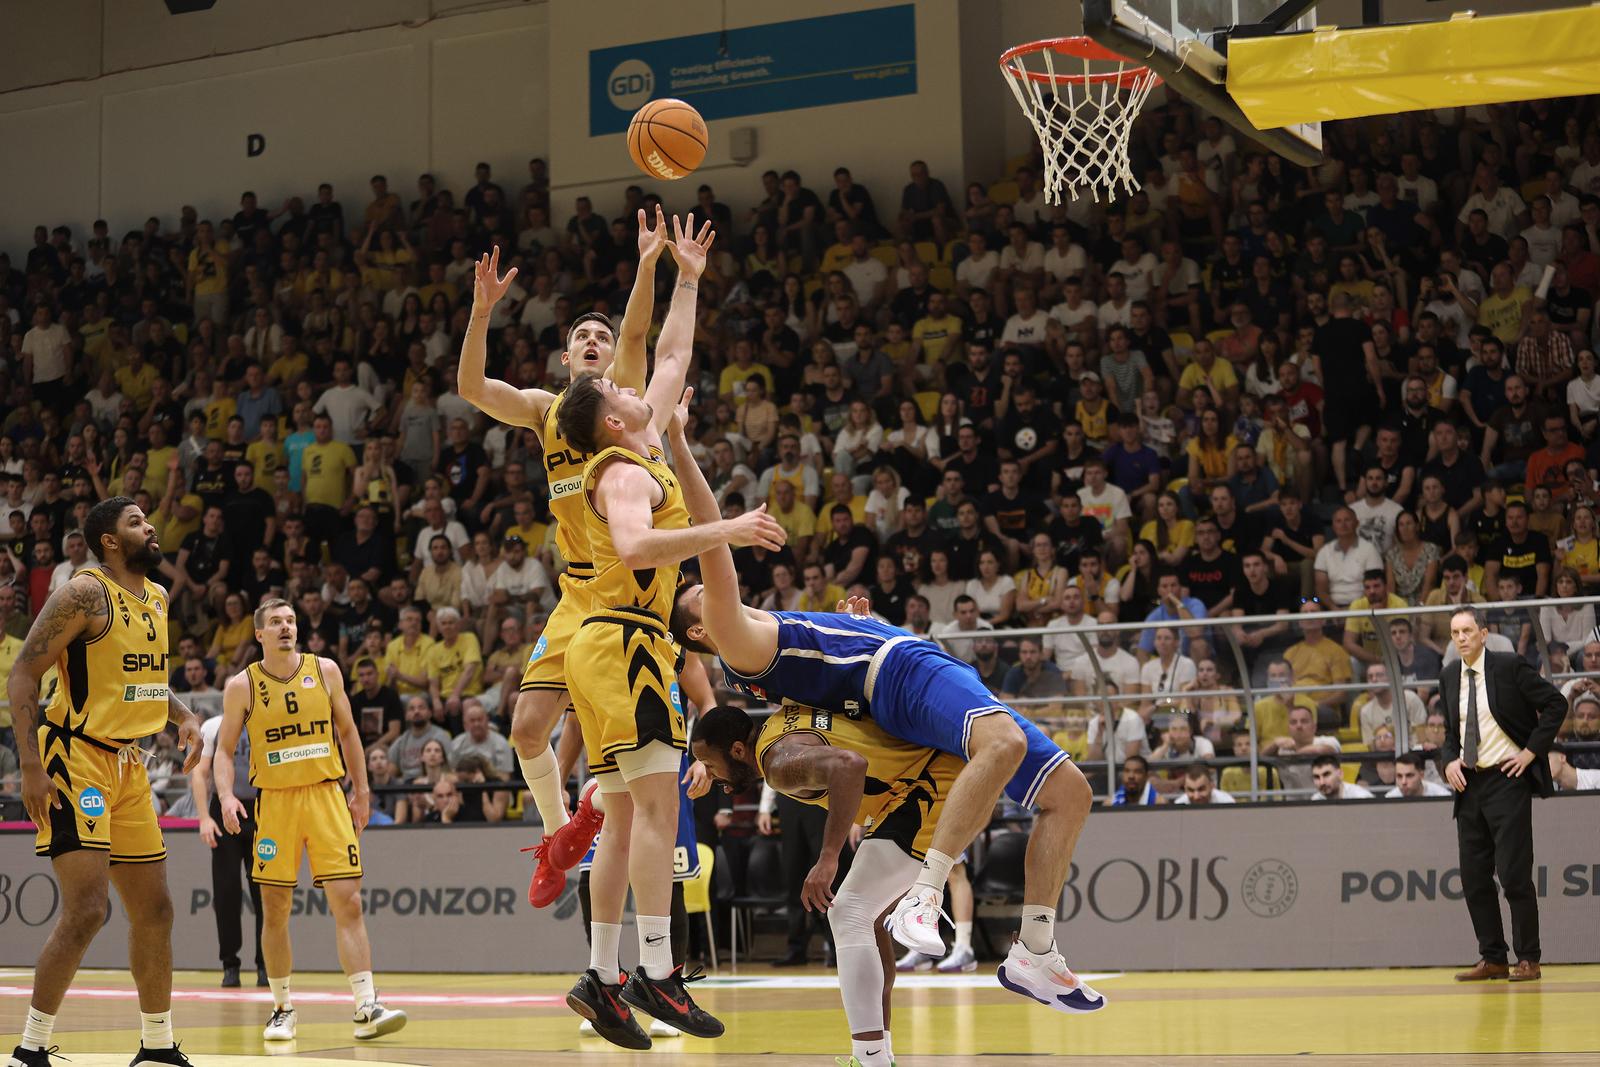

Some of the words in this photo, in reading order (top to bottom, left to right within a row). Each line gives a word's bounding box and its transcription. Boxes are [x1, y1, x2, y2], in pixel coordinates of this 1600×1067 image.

[611, 73, 651, 96] GDi
[247, 134, 265, 157] D
[553, 480, 582, 494] Grou
[142, 612, 157, 642] 3
[122, 653, 168, 672] SPLI
[284, 691, 299, 714] 6
[265, 720, 329, 743] SPLIT
[282, 745, 329, 760] Groupama
[80, 795, 105, 809] GDi
[257, 844, 276, 856] GDi
[347, 844, 358, 867] 6
[1056, 856, 1229, 923] BOBIS
